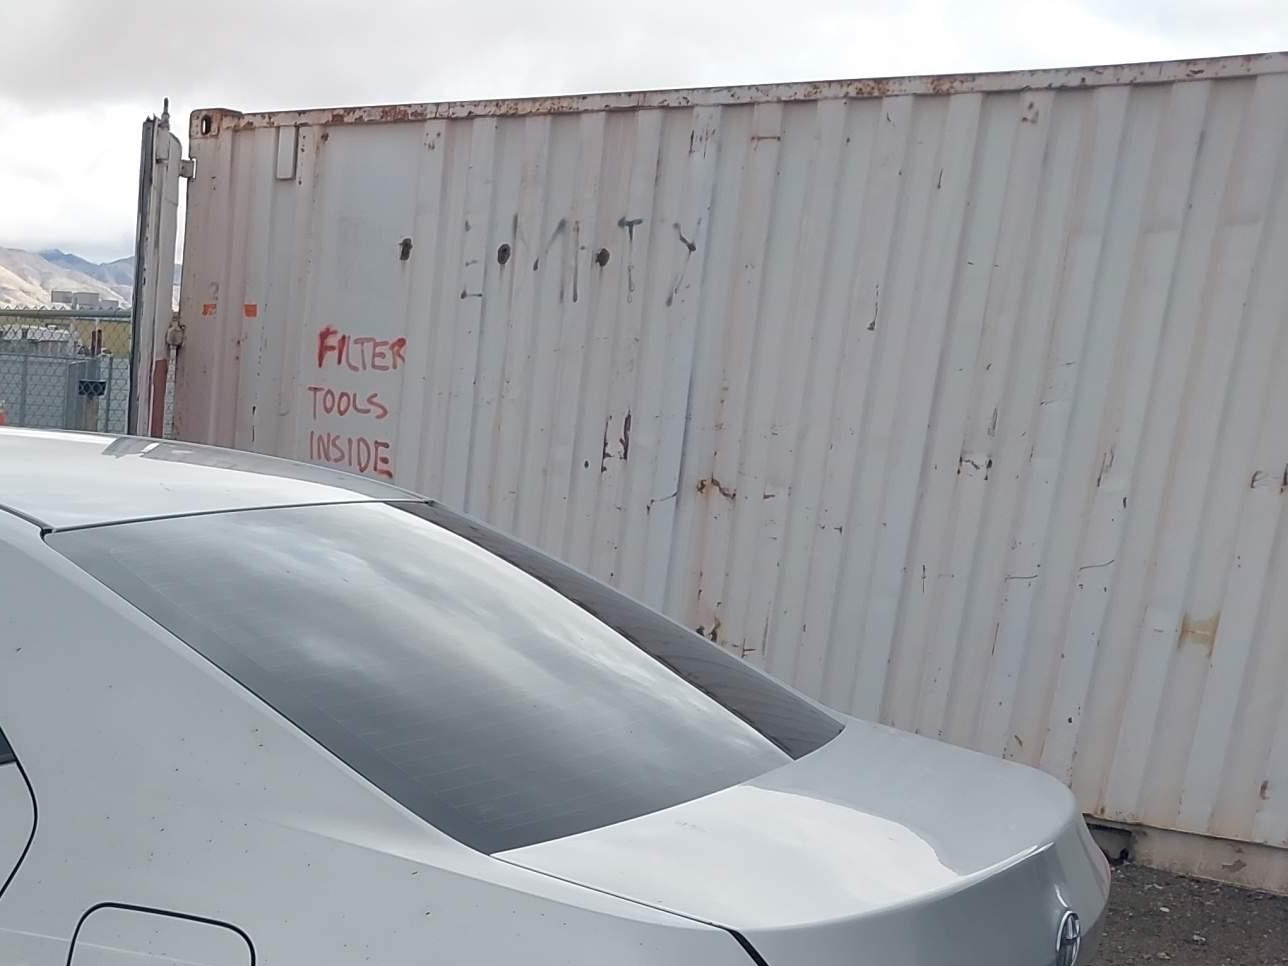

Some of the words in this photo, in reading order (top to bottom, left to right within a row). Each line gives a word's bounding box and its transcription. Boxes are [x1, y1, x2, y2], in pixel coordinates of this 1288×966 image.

[317, 325, 408, 372] FILTER
[308, 386, 389, 420] TOOLS
[309, 431, 393, 478] INSIDE
